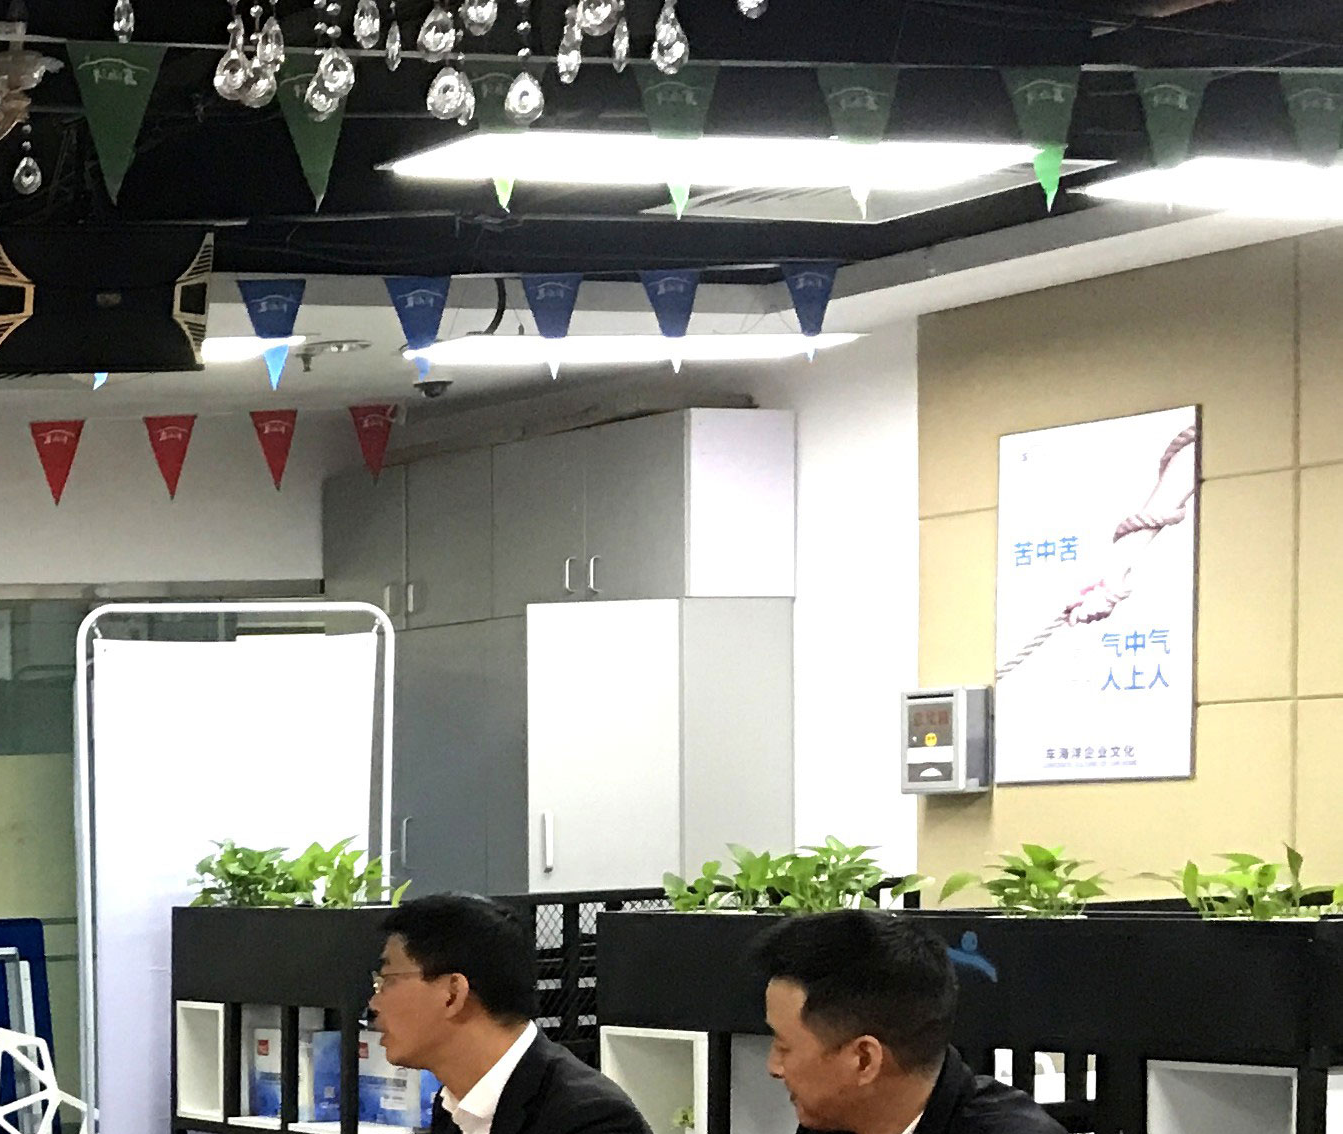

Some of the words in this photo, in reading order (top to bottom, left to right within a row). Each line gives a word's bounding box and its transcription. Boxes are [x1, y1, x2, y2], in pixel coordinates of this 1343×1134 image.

[1014, 536, 1078, 567] 苦中苦
[1102, 629, 1171, 657] 气中气
[1101, 663, 1170, 691] 人上人
